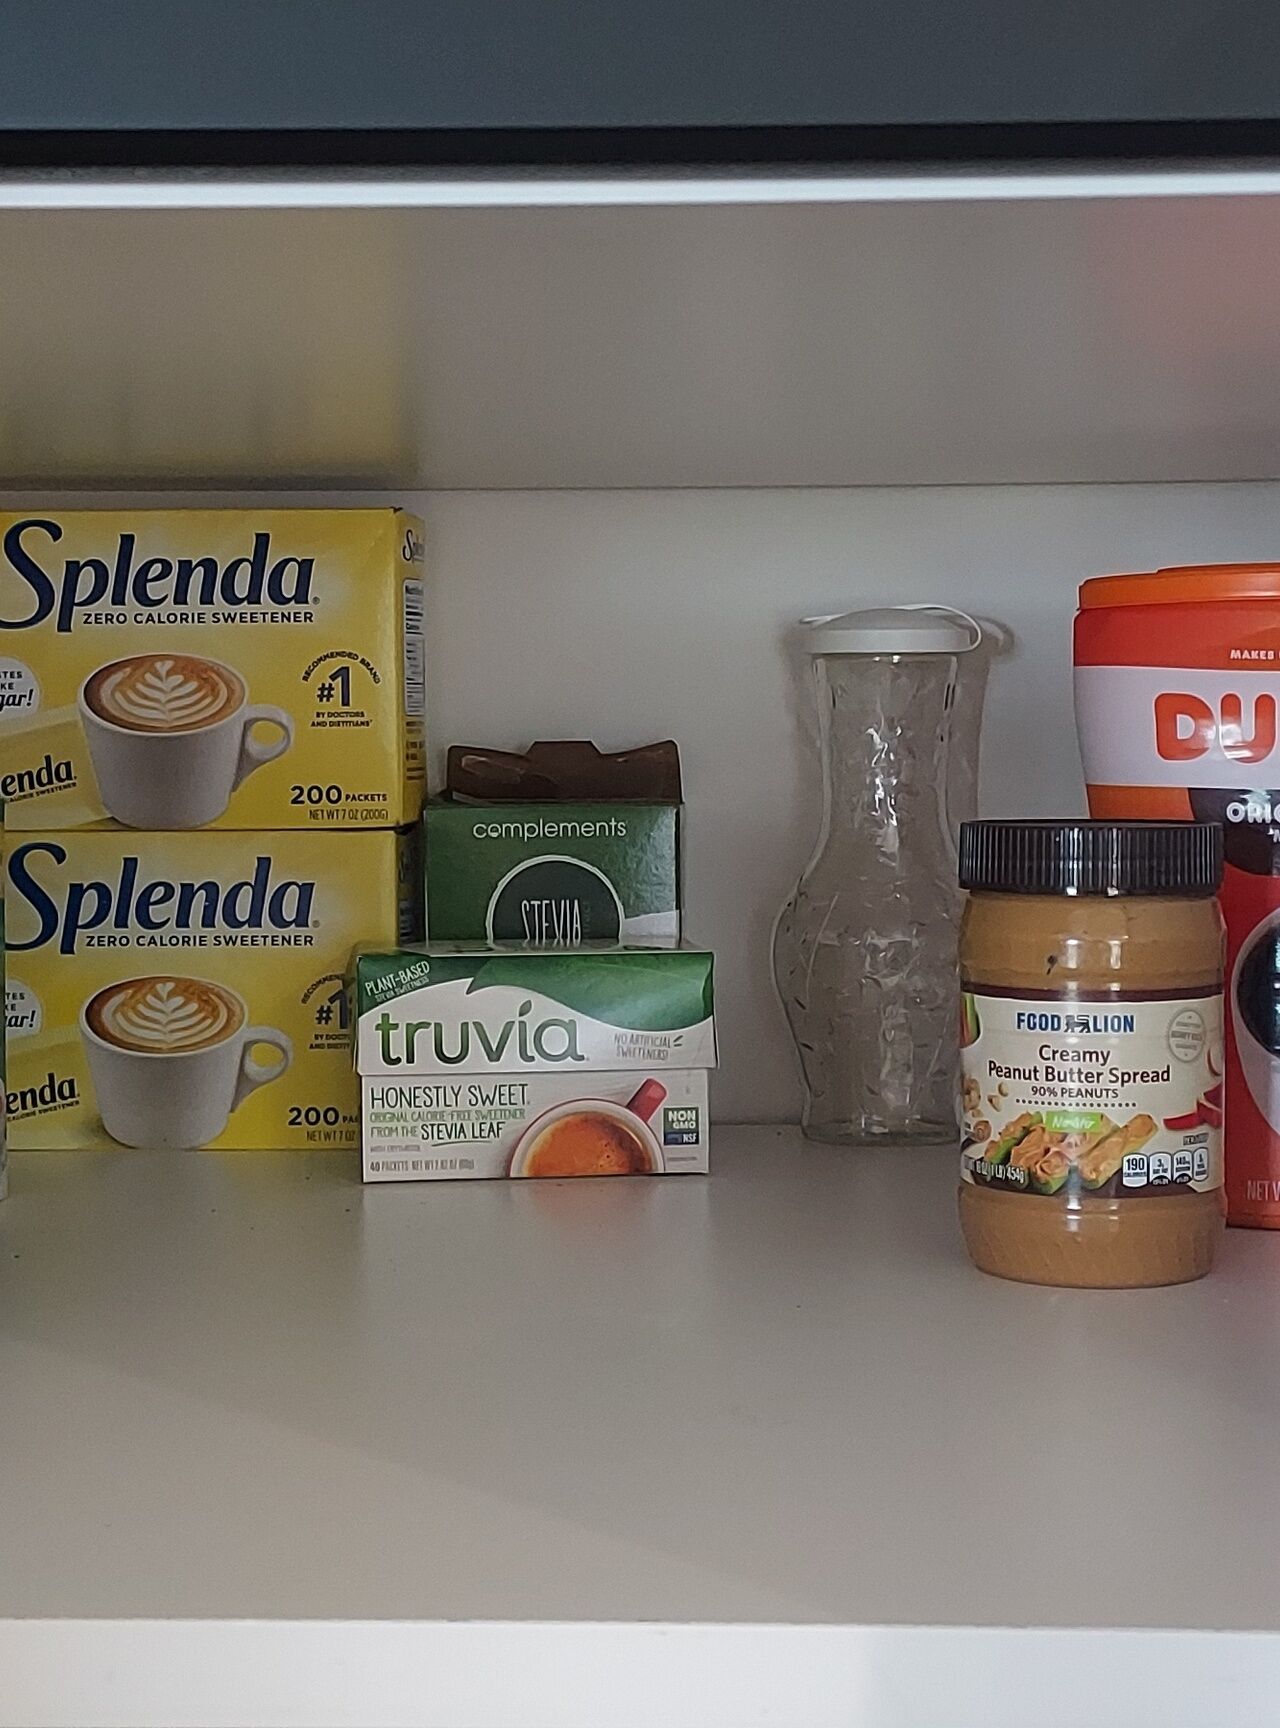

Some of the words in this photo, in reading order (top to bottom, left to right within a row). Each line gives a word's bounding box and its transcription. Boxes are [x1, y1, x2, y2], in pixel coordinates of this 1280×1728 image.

[83, 612, 128, 625] ZERO
[134, 611, 207, 625] CALORIE
[211, 610, 314, 624] SWEETENER
[1230, 649, 1274, 660] MAKES
[359, 657, 381, 684] BRAND
[317, 666, 351, 707] #1
[290, 785, 342, 805] 200
[345, 793, 387, 802] PACKETS
[309, 810, 324, 820] NET
[327, 810, 340, 820] WT
[473, 817, 627, 843] complements
[5, 842, 316, 955] Splenda
[521, 899, 582, 947] STEVIA
[86, 935, 130, 947] ZERO
[136, 934, 208, 947] CALORIE
[213, 933, 314, 947] SWEETENER
[364, 961, 430, 996] PLANT-BASED
[315, 988, 349, 1029] #1
[1017, 1012, 1062, 1032] FOOD
[1093, 1014, 1135, 1033] LION
[1039, 1044, 1110, 1066] Creamy
[988, 1060, 1039, 1082] Peanut
[1045, 1065, 1104, 1085] Butter
[1109, 1064, 1170, 1087] Spread
[6, 1072, 76, 1115] enda
[371, 1085, 462, 1110] HONESTLY
[468, 1083, 529, 1107] SWEET
[1031, 1086, 1058, 1098] 90%
[1061, 1088, 1119, 1099] PEANUTS
[288, 1106, 339, 1126] 200
[370, 1110, 409, 1124] ORIGINAL
[475, 1108, 526, 1122] SWEETENER
[668, 1110, 696, 1121] NON
[673, 1121, 696, 1129] GMO
[370, 1125, 399, 1138] FROM
[401, 1125, 418, 1138] THE
[421, 1122, 467, 1141] STEVIA
[471, 1121, 506, 1139] LEAF
[683, 1133, 697, 1143] NSF
[370, 1161, 380, 1171] 40
[1126, 1157, 1145, 1171] 190
[1247, 1180, 1269, 1201] NET
